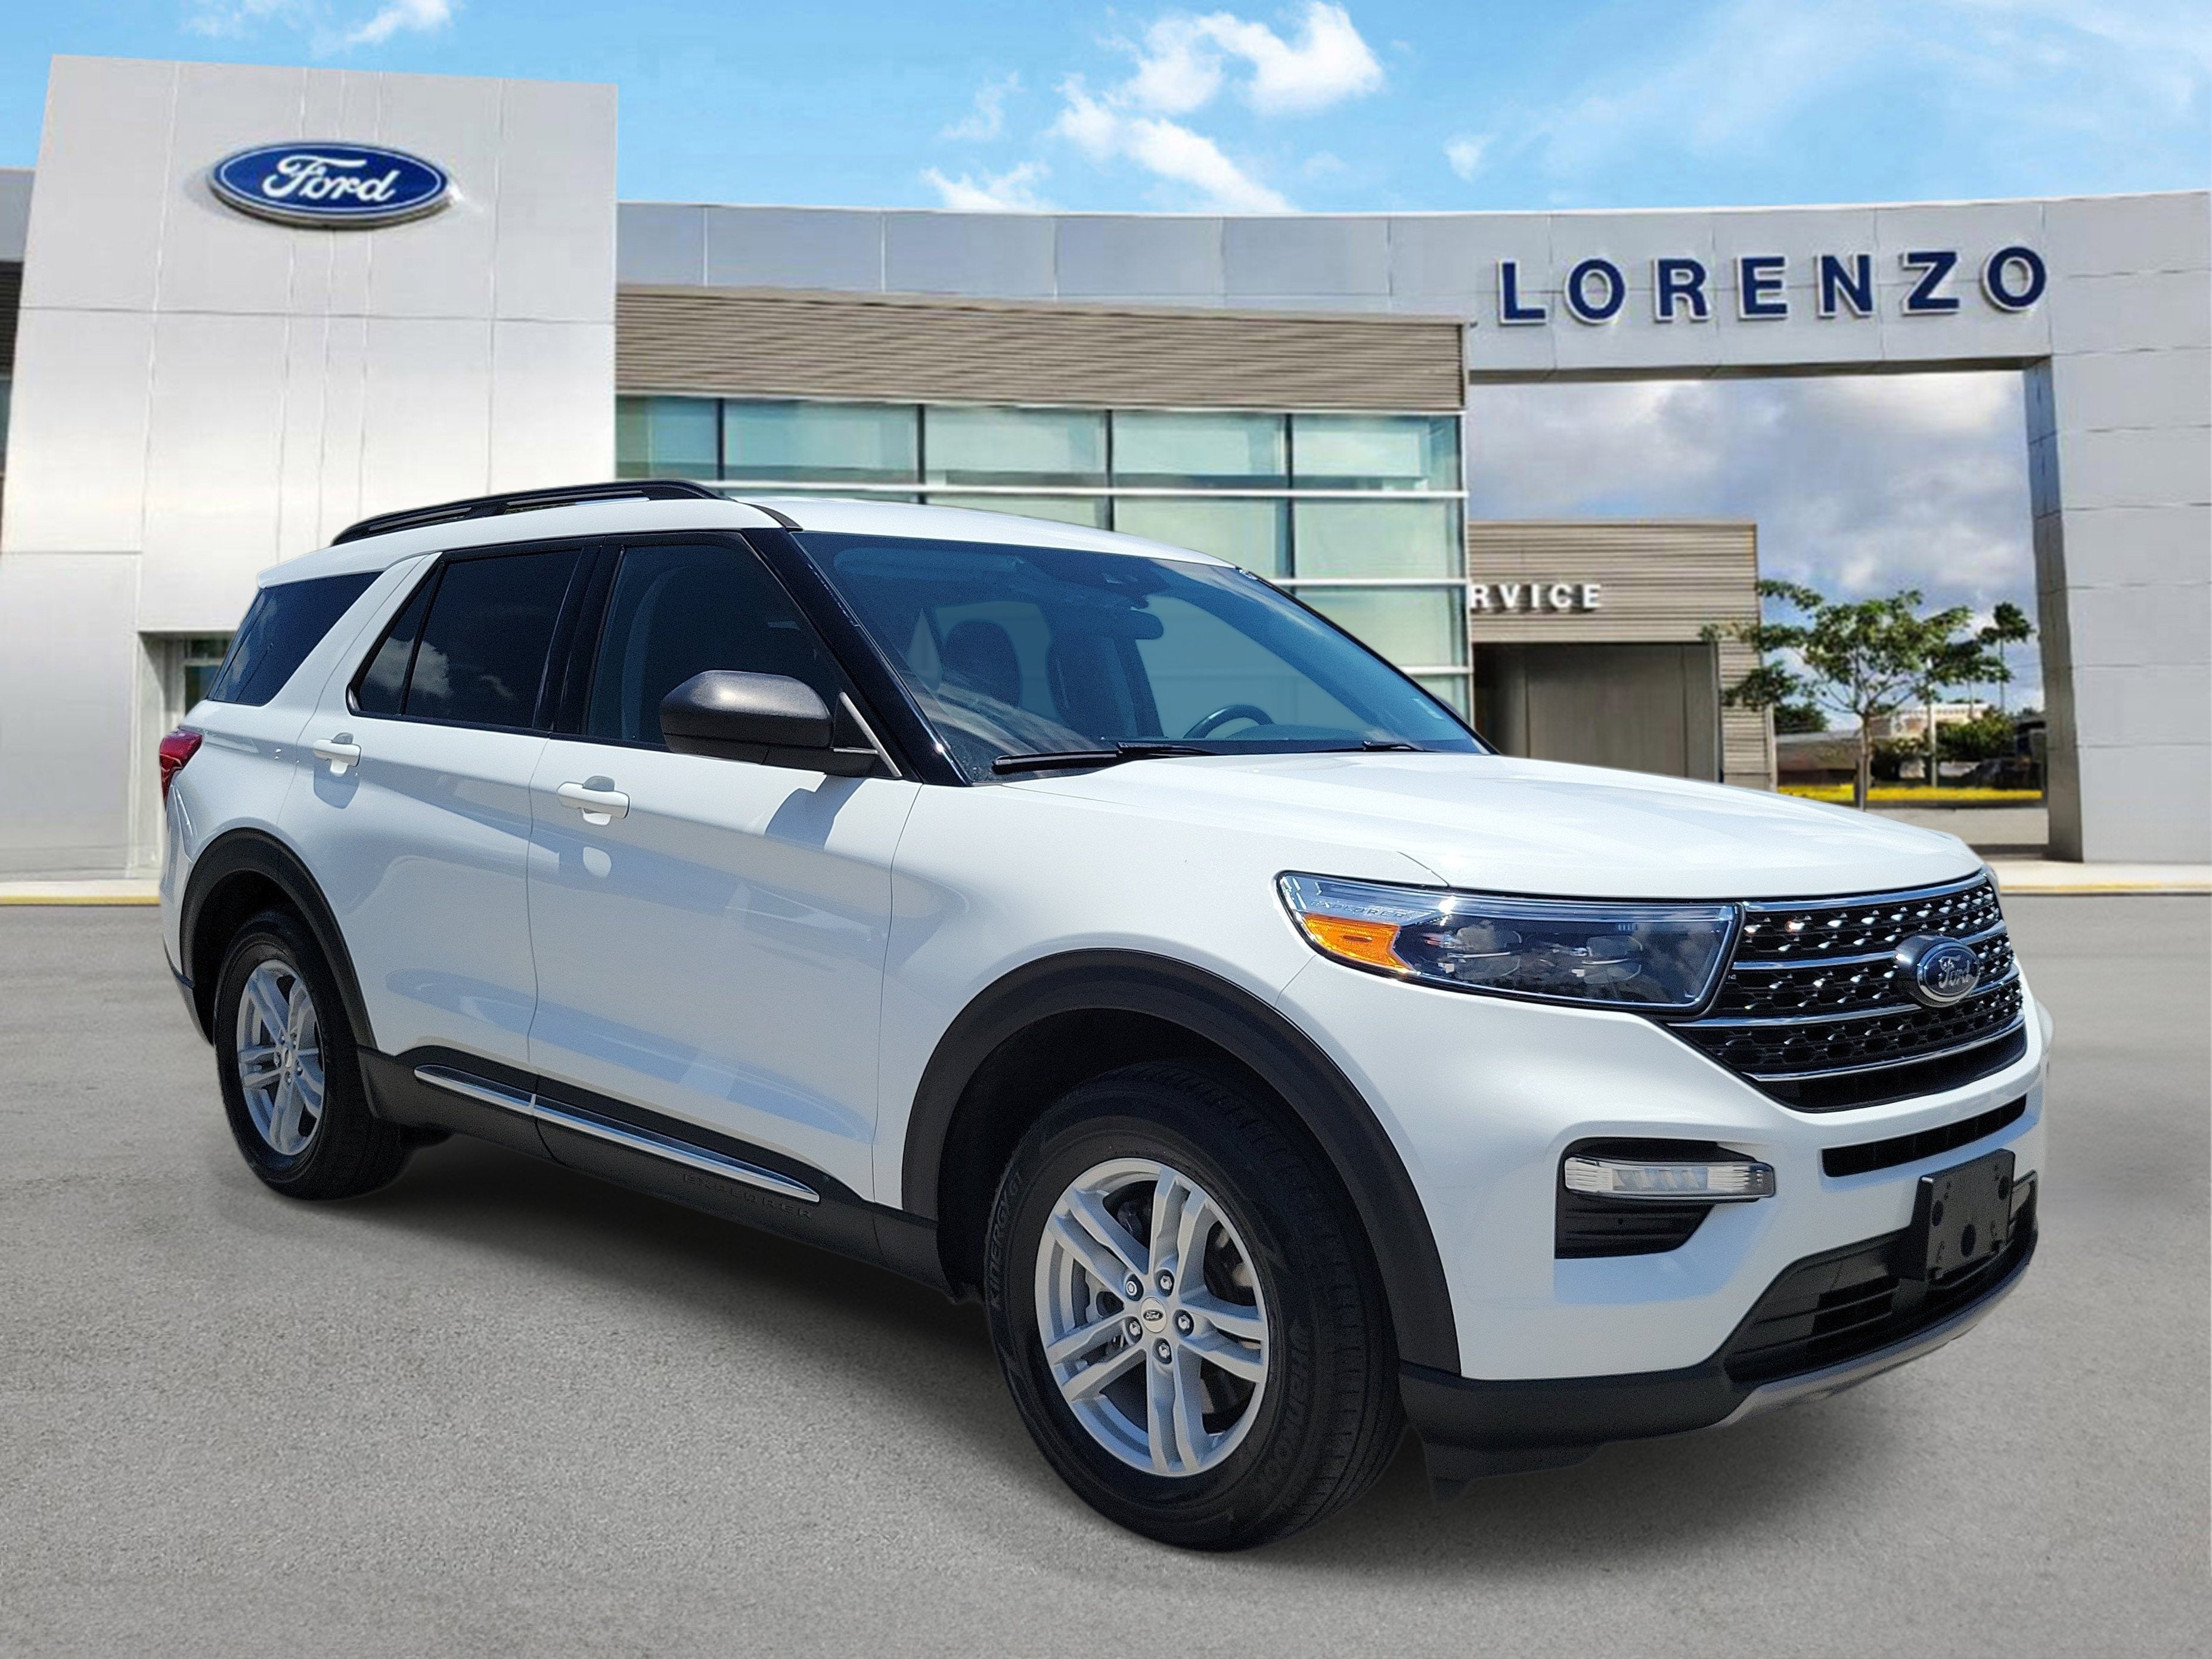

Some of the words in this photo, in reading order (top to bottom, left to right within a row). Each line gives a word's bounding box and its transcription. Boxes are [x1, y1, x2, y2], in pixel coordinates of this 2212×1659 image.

[262, 154, 400, 202] Ford
[1498, 246, 2047, 325] LORENZO
[1938, 954, 1971, 990] Ford
